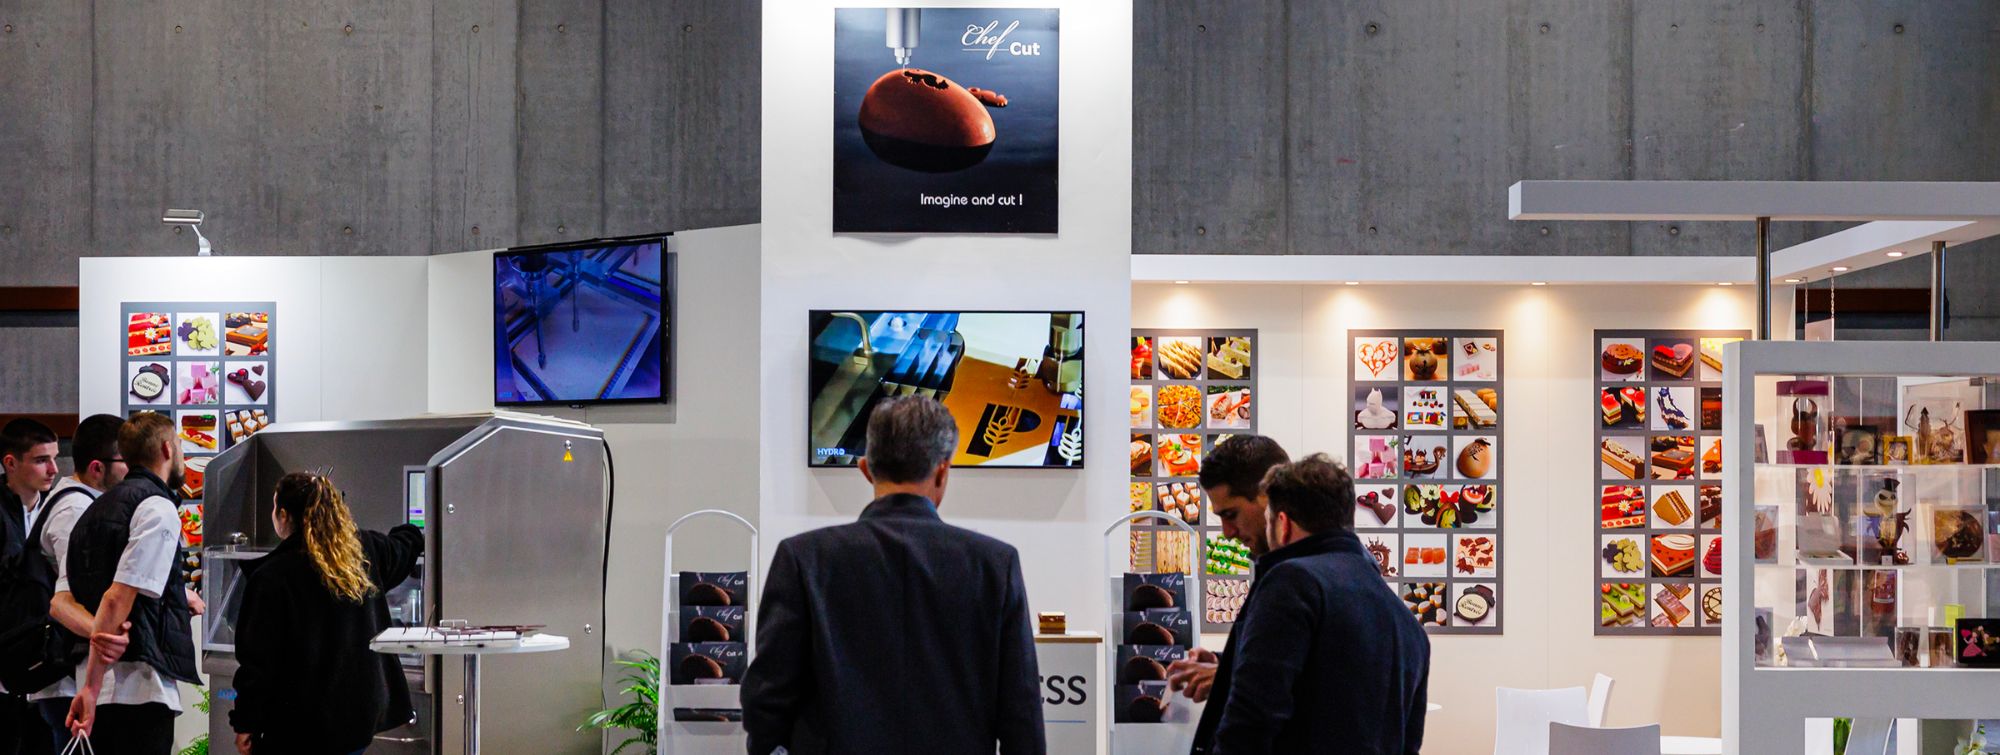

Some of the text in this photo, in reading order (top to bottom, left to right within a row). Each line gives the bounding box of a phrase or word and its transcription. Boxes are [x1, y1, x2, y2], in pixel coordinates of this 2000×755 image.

[961, 20, 1041, 60] Chef Cut
[921, 193, 1023, 208] Imagine and cut !
[1039, 675, 1087, 706] SS
